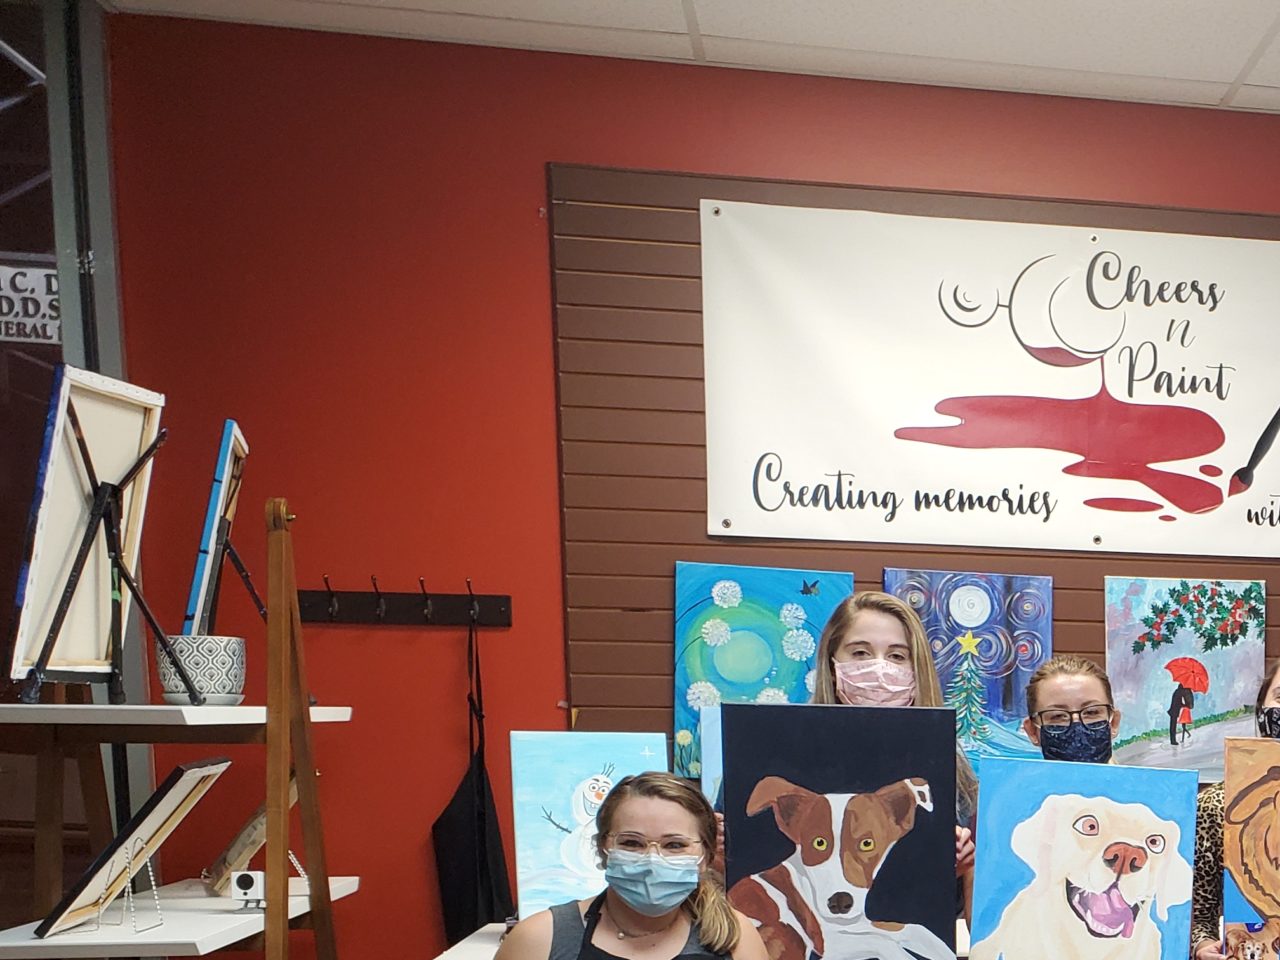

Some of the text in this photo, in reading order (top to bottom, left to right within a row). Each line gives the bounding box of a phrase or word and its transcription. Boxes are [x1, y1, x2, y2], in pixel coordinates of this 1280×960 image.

[9, 271, 36, 295] C.
[1086, 250, 1226, 312] Cheers
[0, 320, 54, 341] ERAL
[1165, 318, 1196, 348] n
[1118, 341, 1237, 401] Paint
[752, 452, 1058, 523] Creating memories
